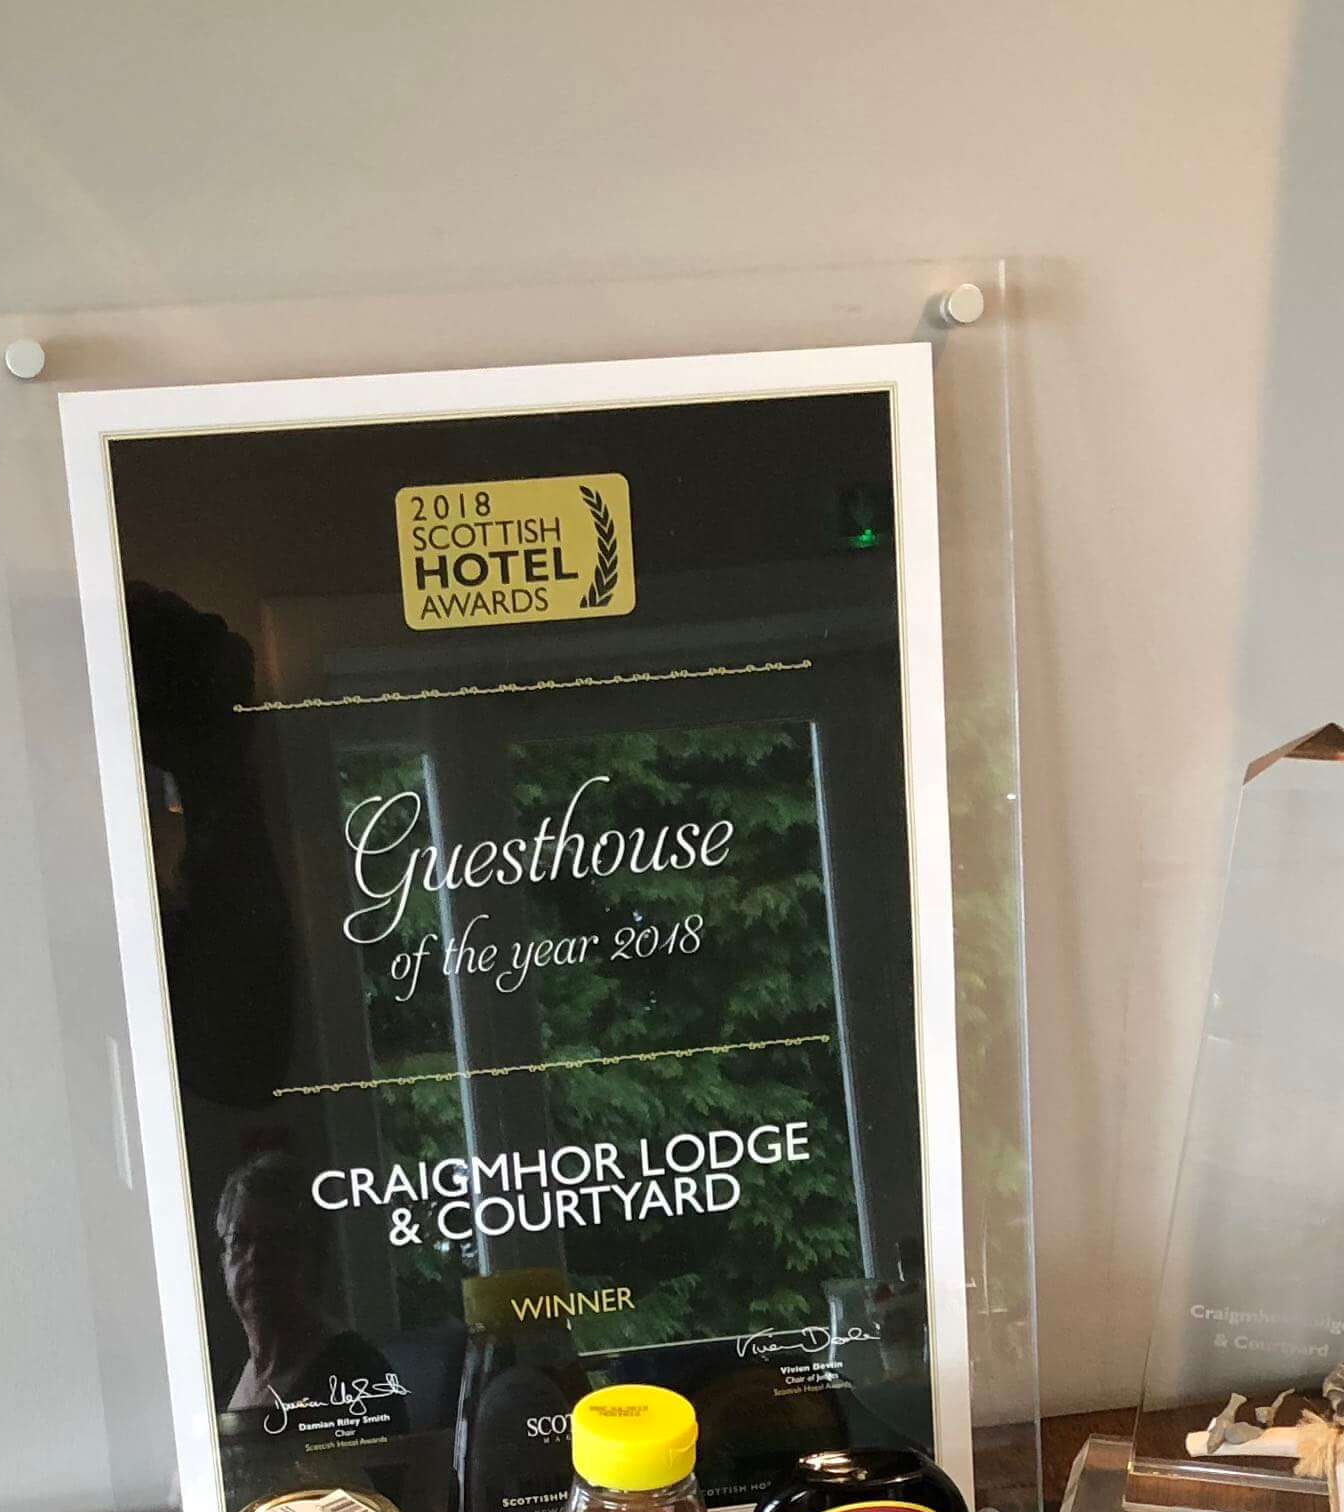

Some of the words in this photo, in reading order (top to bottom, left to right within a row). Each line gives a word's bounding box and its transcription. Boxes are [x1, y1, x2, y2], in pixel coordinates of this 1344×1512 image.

[411, 492, 491, 521] 2018
[412, 517, 561, 551] SCOTTISH
[415, 547, 578, 590] HOTEL
[420, 587, 549, 620] AWARDS
[343, 775, 734, 944] Guesthouse
[391, 934, 438, 1001] of
[442, 914, 496, 975] the
[496, 935, 599, 993] year
[610, 913, 704, 961] 2018
[311, 1142, 625, 1211] CRAIGMHOR
[640, 1121, 810, 1177] LODGE
[388, 1207, 423, 1247] &
[437, 1173, 741, 1242] COURTYARD
[511, 1287, 635, 1322] WINNER
[298, 1420, 335, 1432] Damian
[362, 1413, 391, 1424] Smith
[526, 1413, 572, 1438] SCOT
